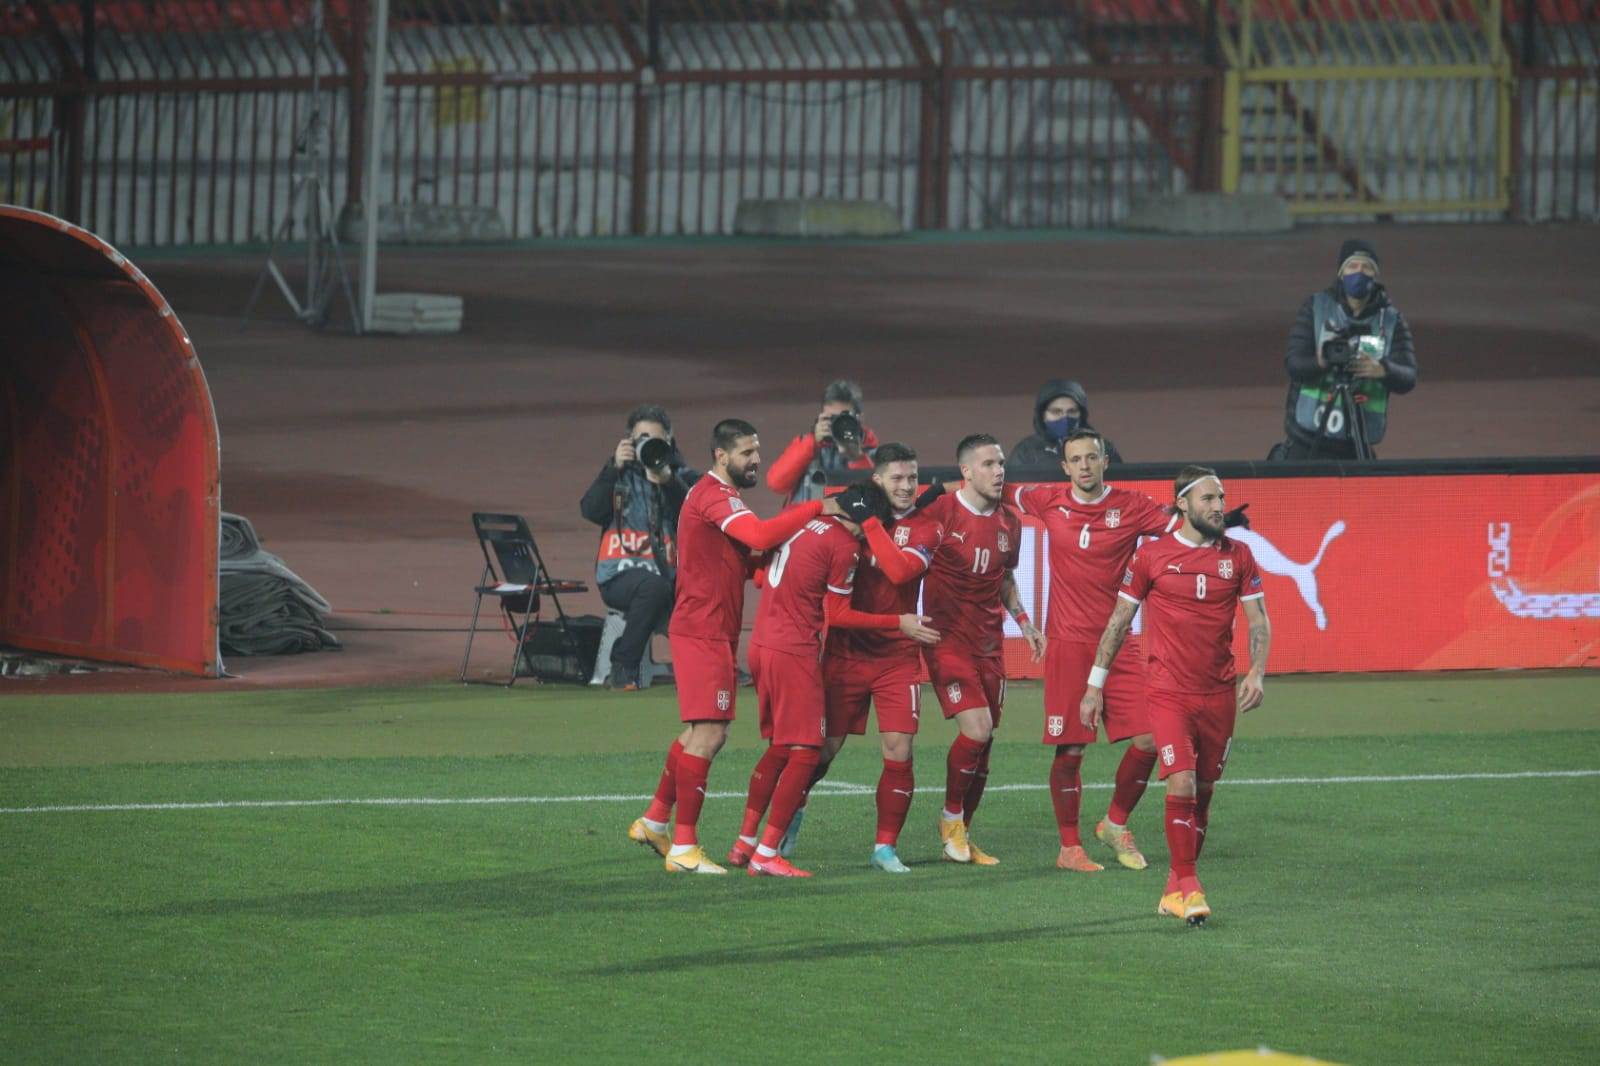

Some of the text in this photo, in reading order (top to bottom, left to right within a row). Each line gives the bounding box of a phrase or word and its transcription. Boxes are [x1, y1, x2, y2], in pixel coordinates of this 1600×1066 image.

[1079, 523, 1090, 549] 6
[972, 547, 991, 574] 19
[1196, 573, 1207, 600] 8
